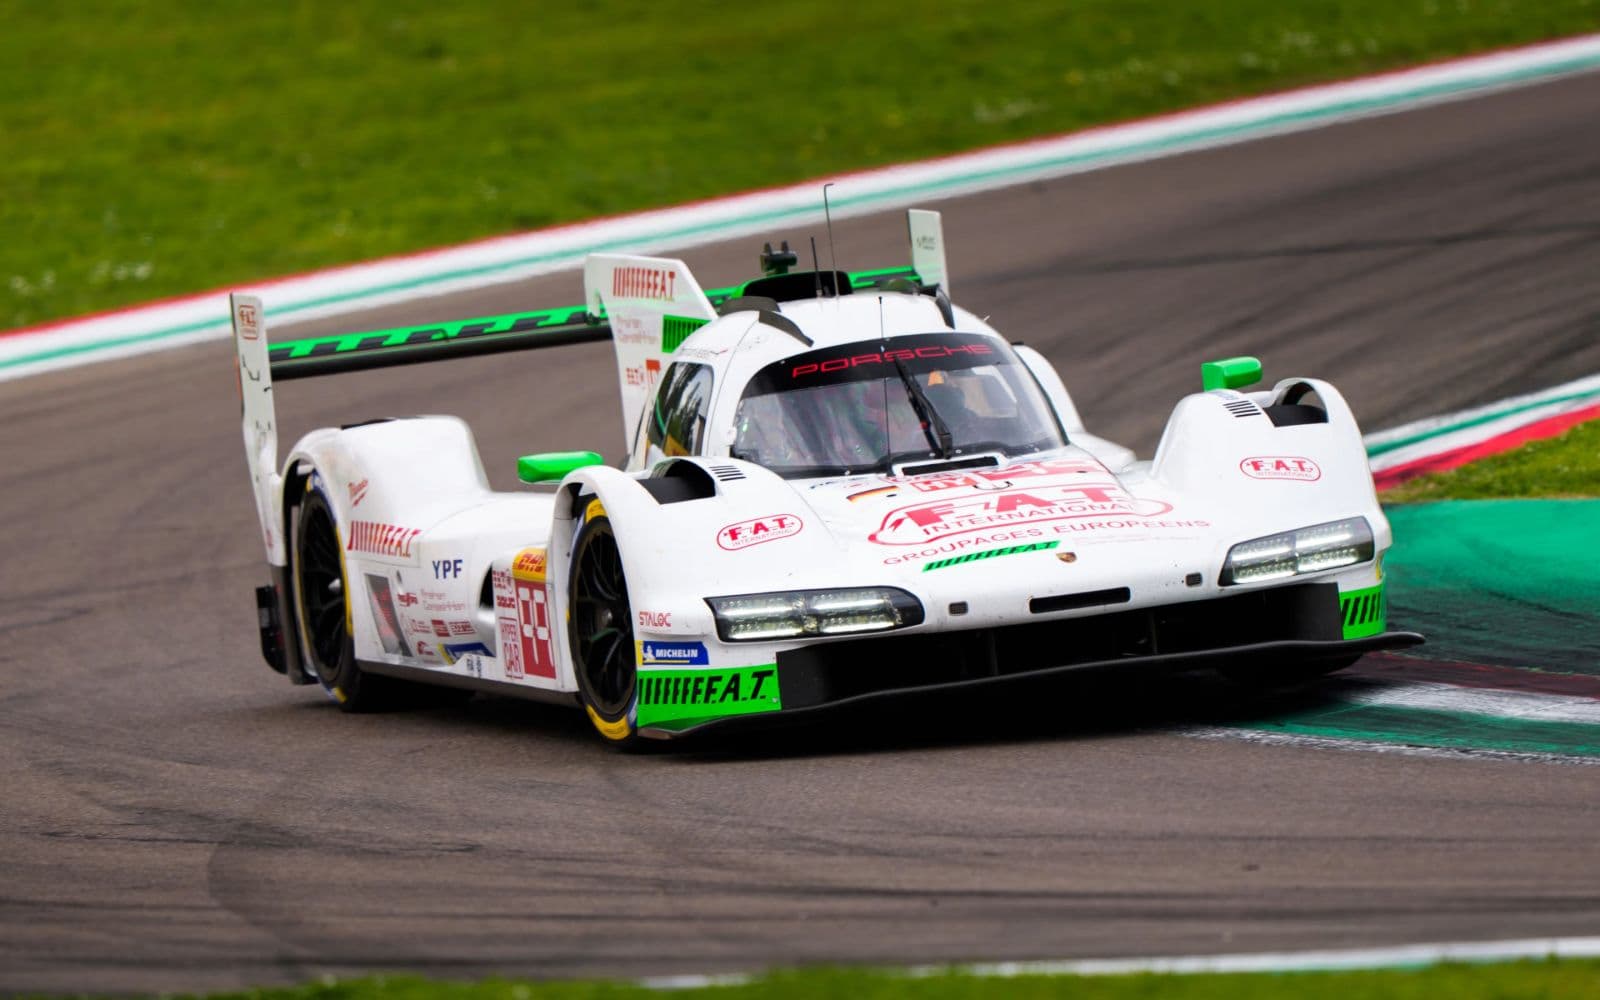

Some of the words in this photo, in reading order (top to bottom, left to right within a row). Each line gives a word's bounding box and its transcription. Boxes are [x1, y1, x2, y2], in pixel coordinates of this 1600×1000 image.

[792, 344, 992, 378] PORSCHE
[883, 528, 1043, 566] GROUPAGES
[432, 559, 463, 579] YPF
[639, 611, 672, 627] STALOC
[655, 648, 698, 659] MICHELIN
